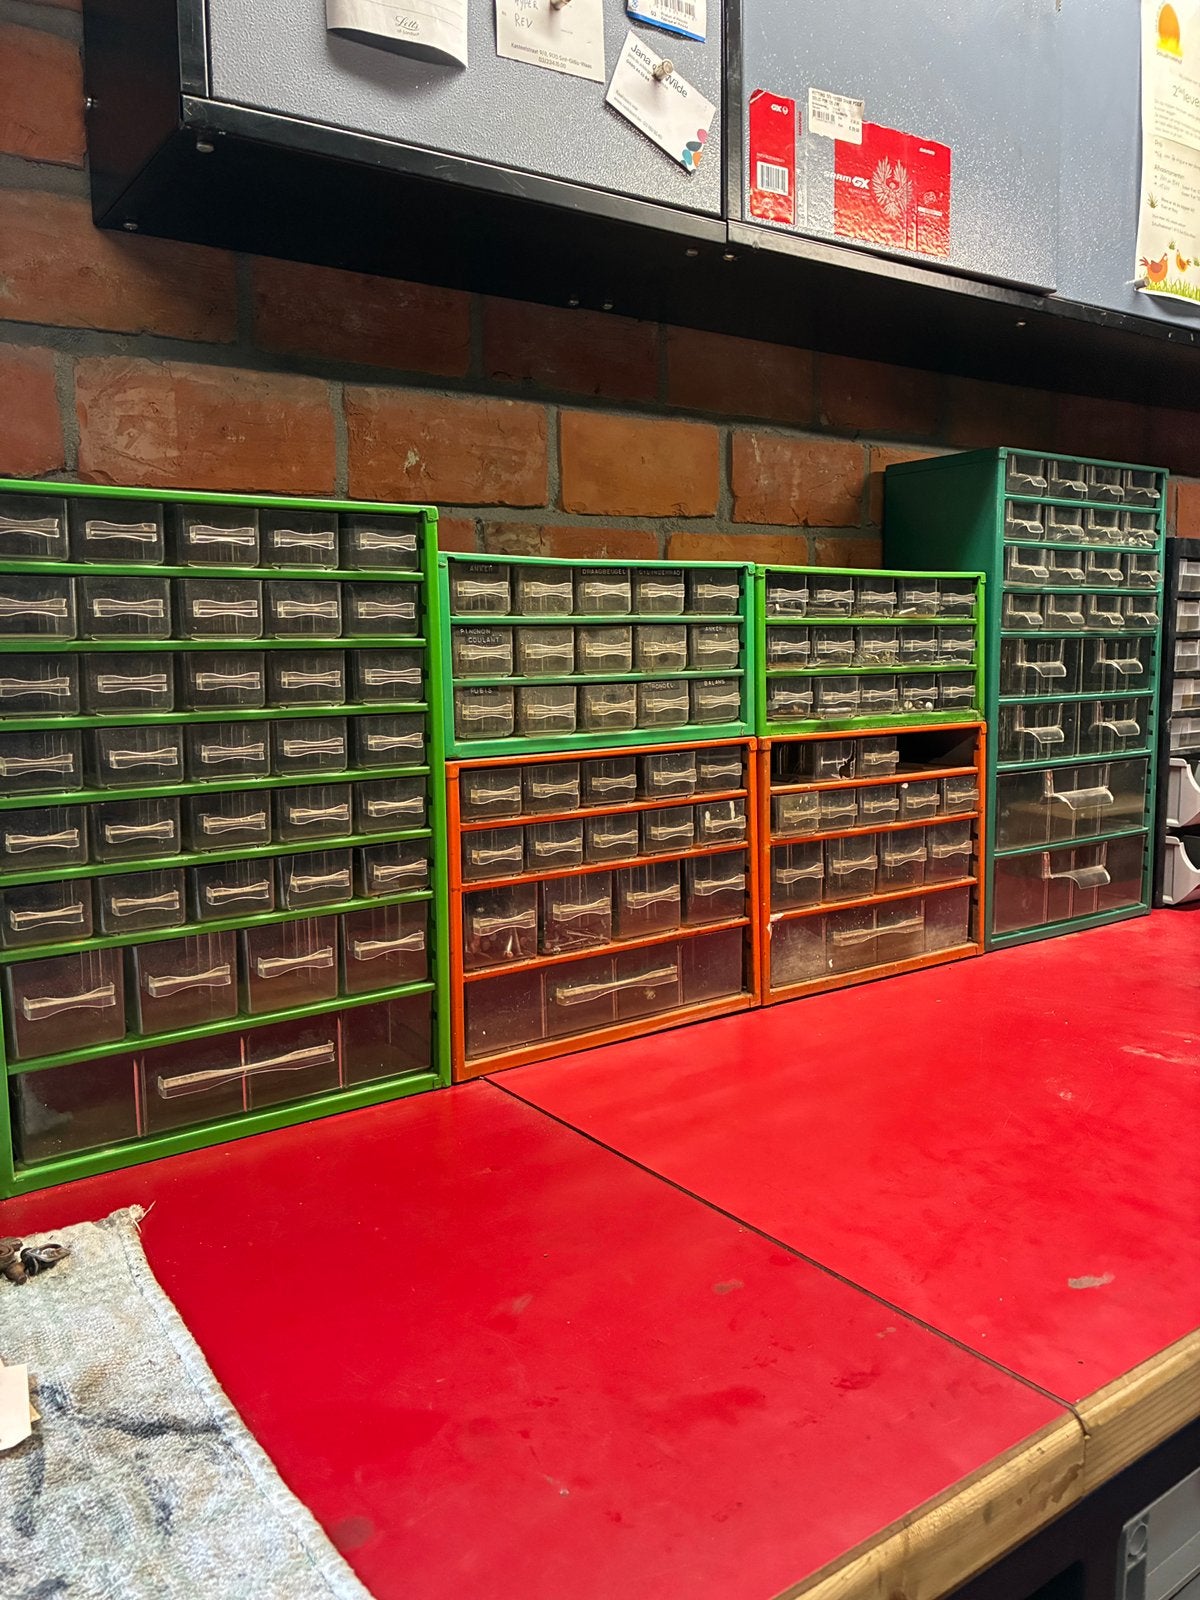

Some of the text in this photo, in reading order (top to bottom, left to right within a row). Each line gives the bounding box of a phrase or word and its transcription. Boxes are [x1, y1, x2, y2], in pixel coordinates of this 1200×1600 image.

[515, 13, 533, 28] REV
[631, 44, 652, 65] Jana
[666, 74, 688, 98] Wilde
[851, 176, 871, 190] GX
